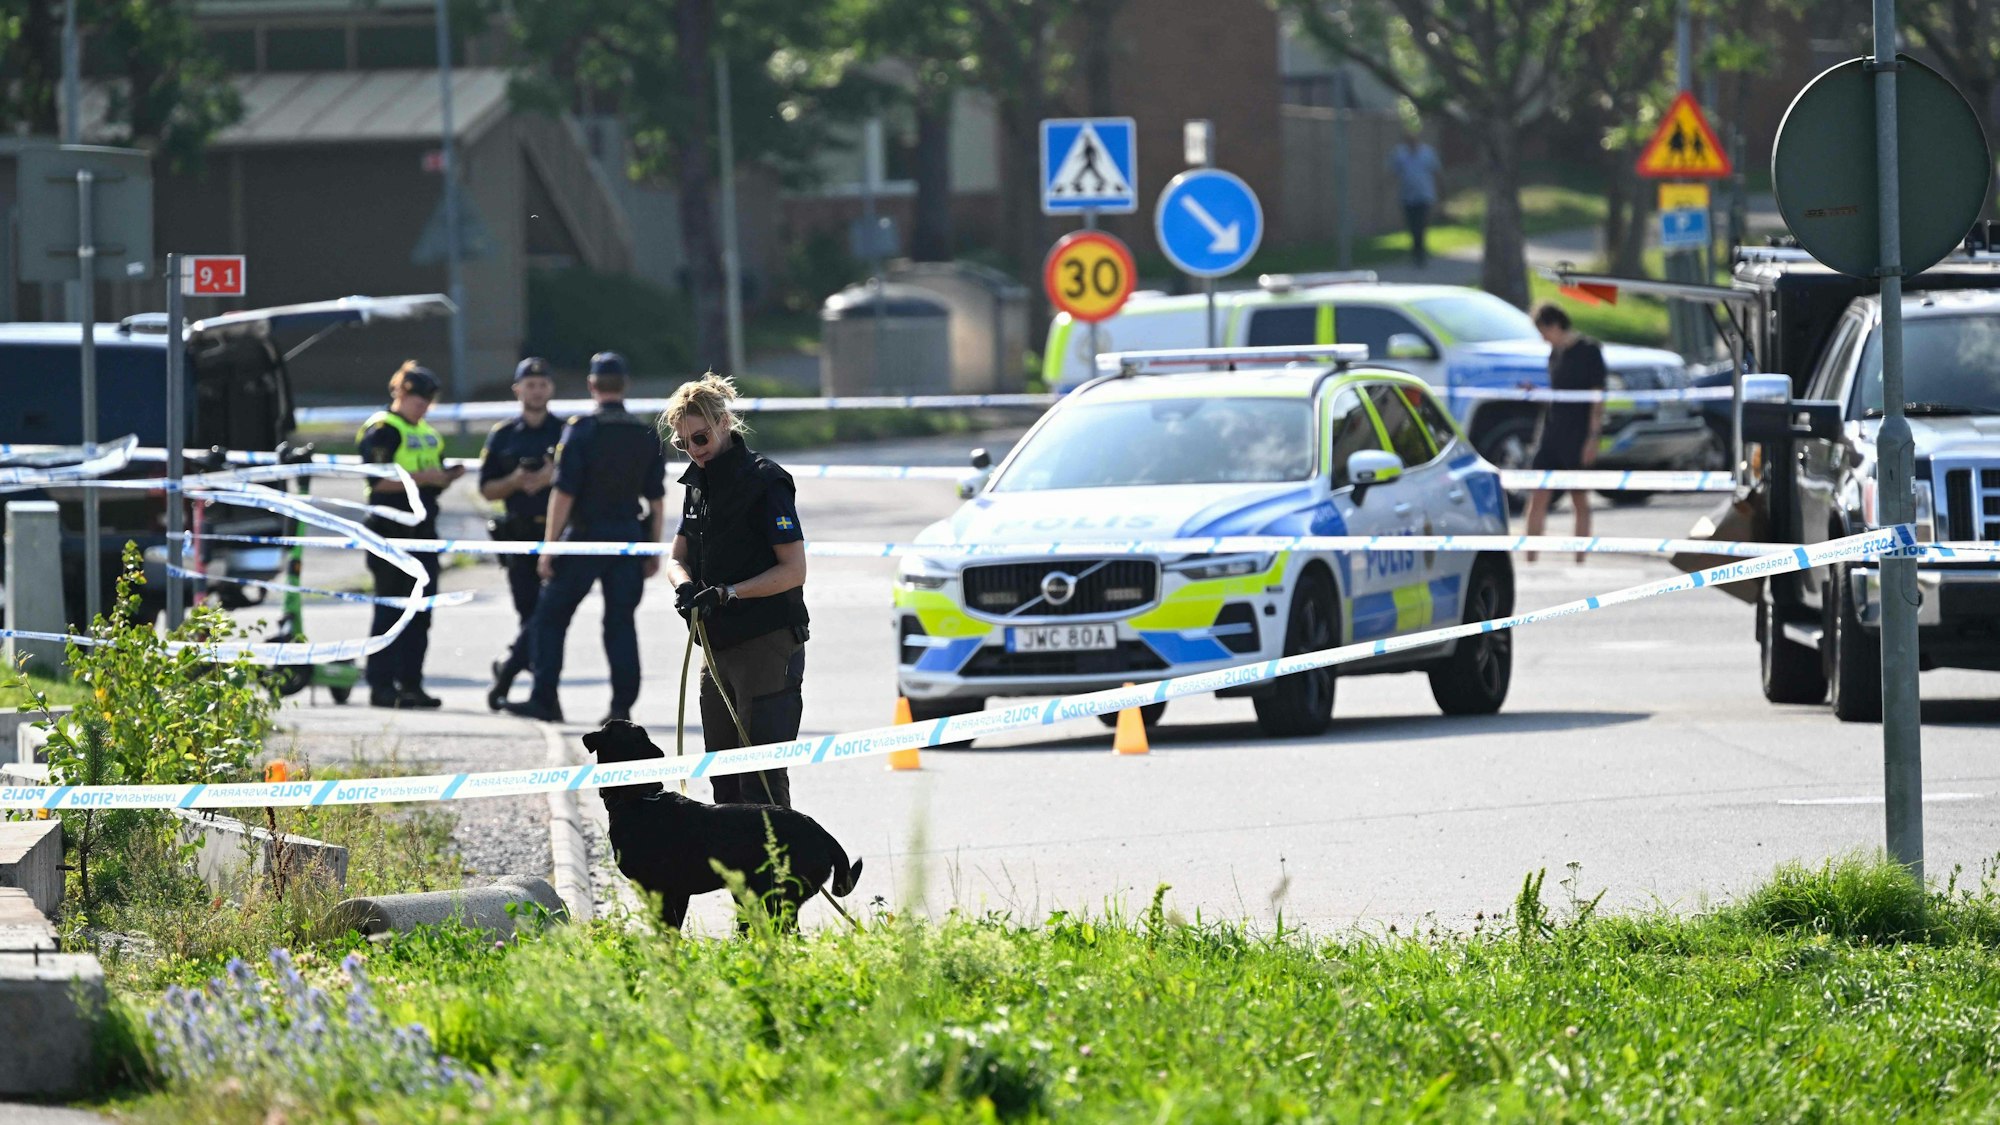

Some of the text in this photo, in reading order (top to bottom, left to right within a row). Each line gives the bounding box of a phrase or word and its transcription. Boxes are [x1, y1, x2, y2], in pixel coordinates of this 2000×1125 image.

[1064, 258, 1120, 299] 30
[1862, 536, 1897, 555] POLIS
[1710, 556, 1793, 582] POLIS AVSPÄRRAT
[1023, 627, 1107, 648] JWC 80A
